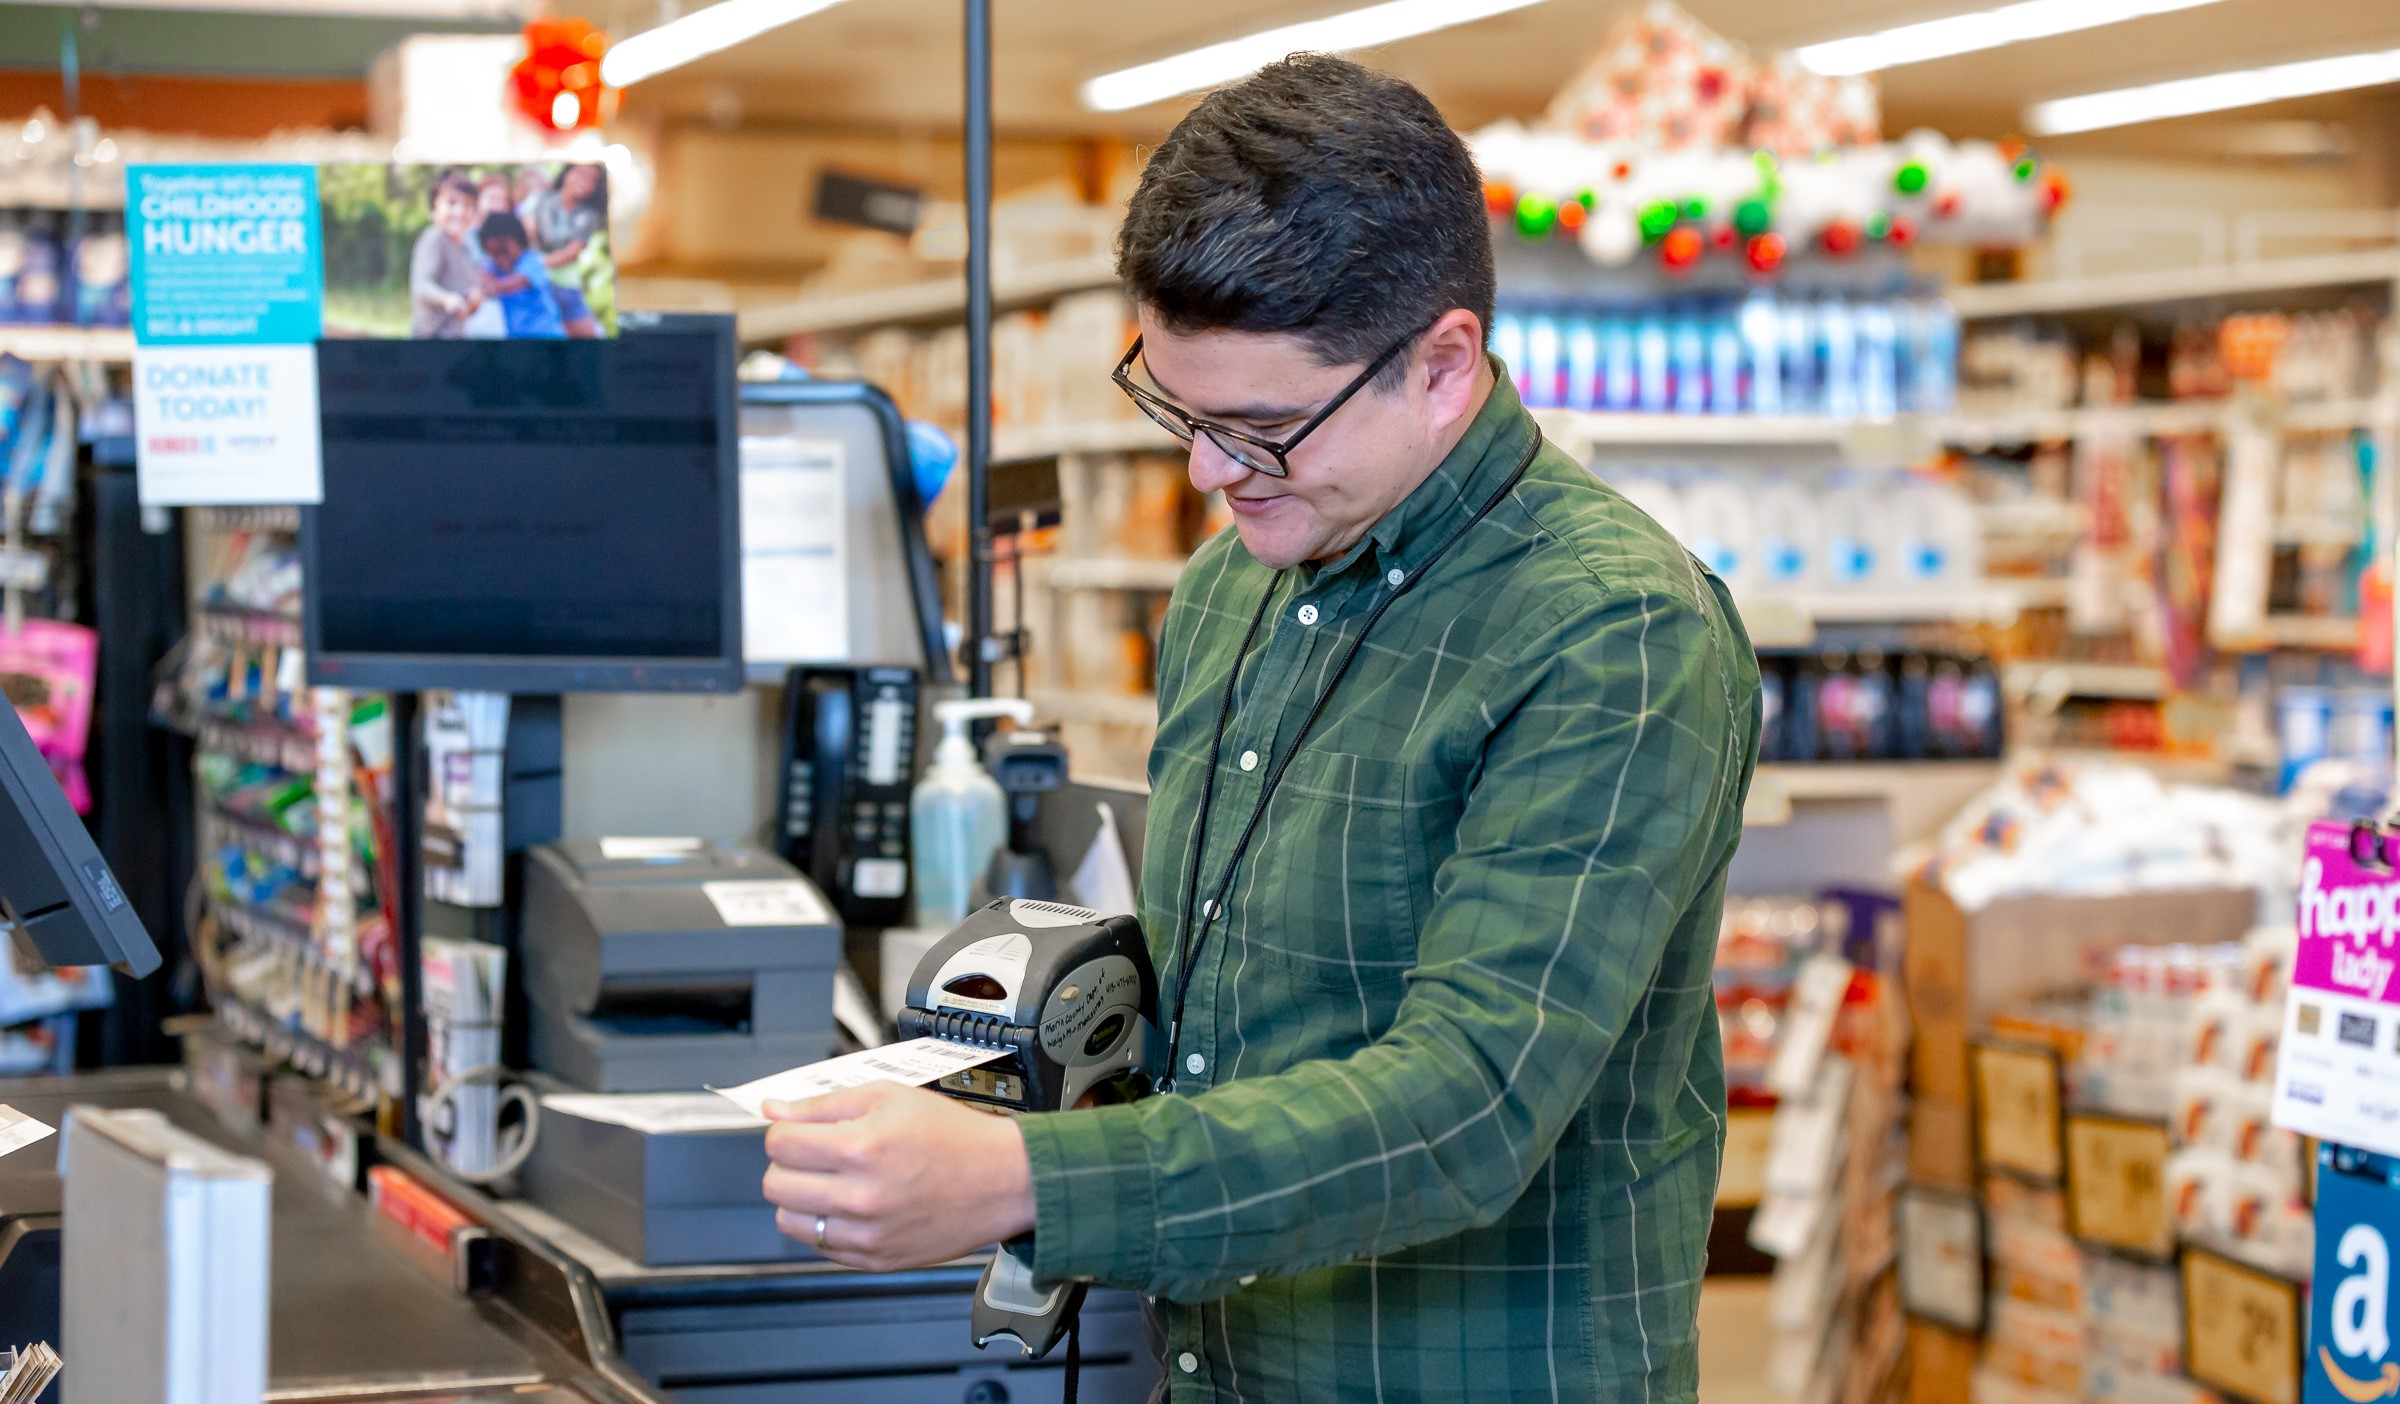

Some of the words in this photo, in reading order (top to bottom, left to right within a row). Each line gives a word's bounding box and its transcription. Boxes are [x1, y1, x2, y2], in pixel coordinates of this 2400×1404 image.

[140, 194, 305, 219] CHILDHOOD
[144, 220, 305, 254] HUNGER
[147, 364, 271, 390] DONATE
[158, 395, 268, 421] TODAY!
[2331, 941, 2396, 1001] lady
[1065, 1001, 1085, 1024] County
[2331, 1223, 2391, 1363] a
